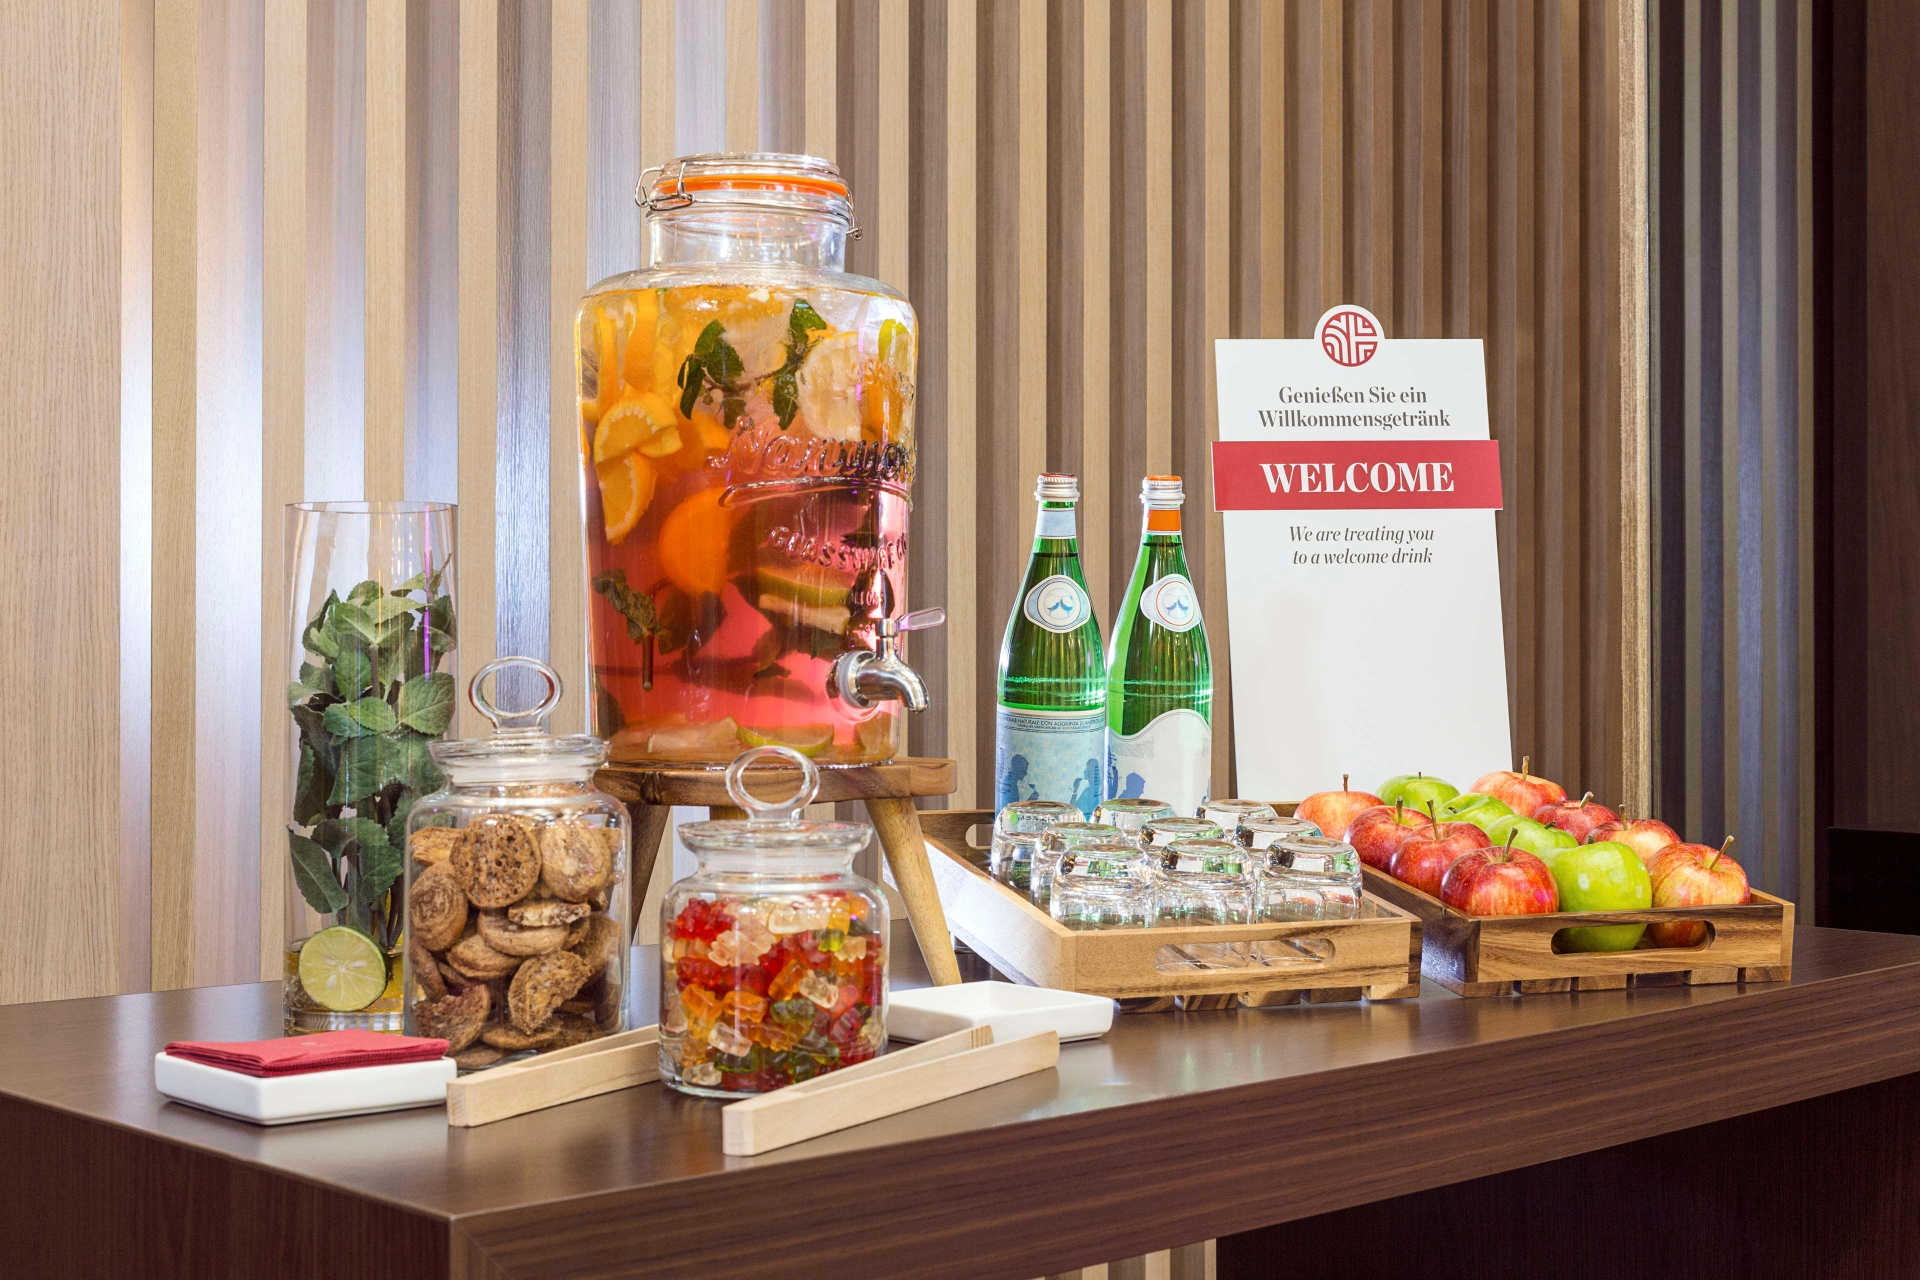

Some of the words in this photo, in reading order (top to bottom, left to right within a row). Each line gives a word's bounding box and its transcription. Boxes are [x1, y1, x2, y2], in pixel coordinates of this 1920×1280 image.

[1278, 386, 1365, 404] Genießen
[1368, 386, 1396, 404] Sie
[1400, 386, 1427, 404] ein
[1258, 409, 1451, 431] Willkommensgetränk
[1258, 462, 1455, 493] WELCOME
[1289, 526, 1313, 542] We
[1316, 530, 1341, 542] are
[1344, 526, 1404, 544] treating
[1406, 528, 1434, 545] you
[1293, 550, 1308, 565] to
[1311, 553, 1320, 565] a
[1324, 549, 1389, 565] welcome
[1392, 548, 1433, 564] drink
